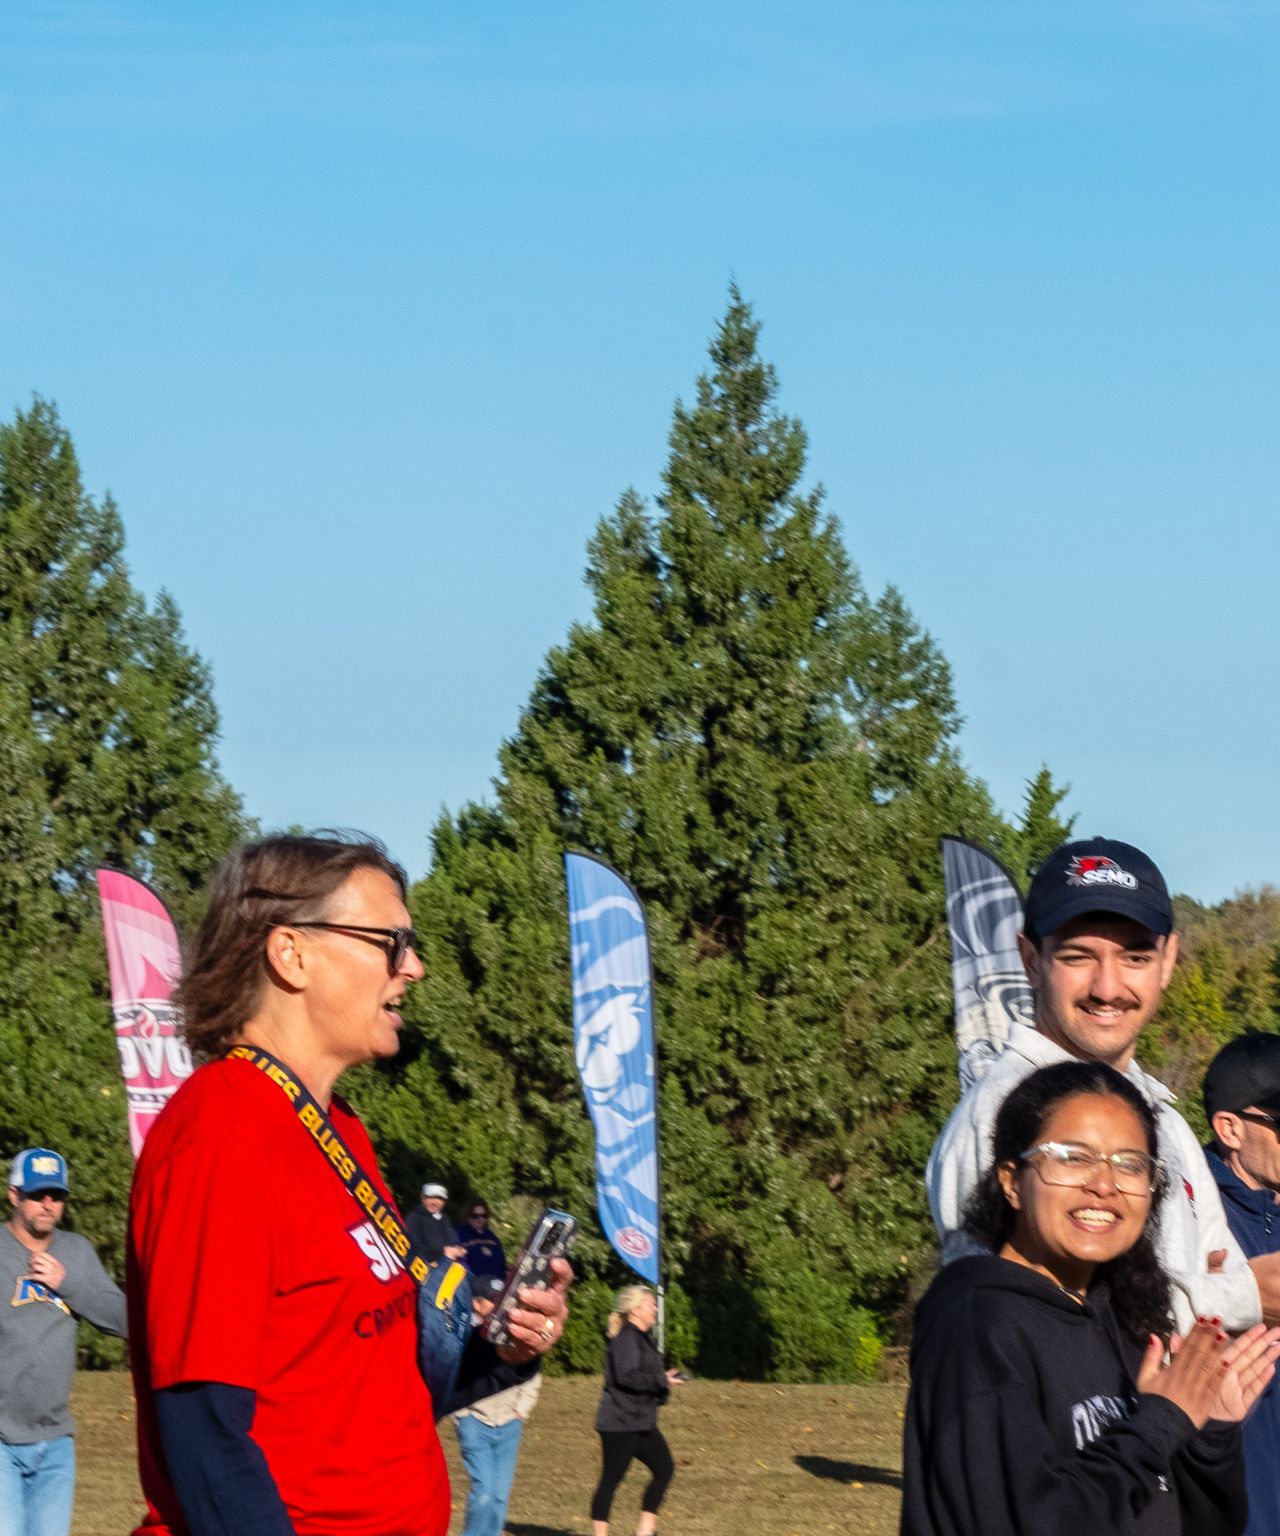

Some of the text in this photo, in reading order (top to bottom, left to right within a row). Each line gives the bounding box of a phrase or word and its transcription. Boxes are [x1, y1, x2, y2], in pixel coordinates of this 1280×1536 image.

[1081, 867, 1137, 890] SEMO
[298, 1102, 356, 1182] BLUES
[354, 1178, 411, 1258] BLUES
